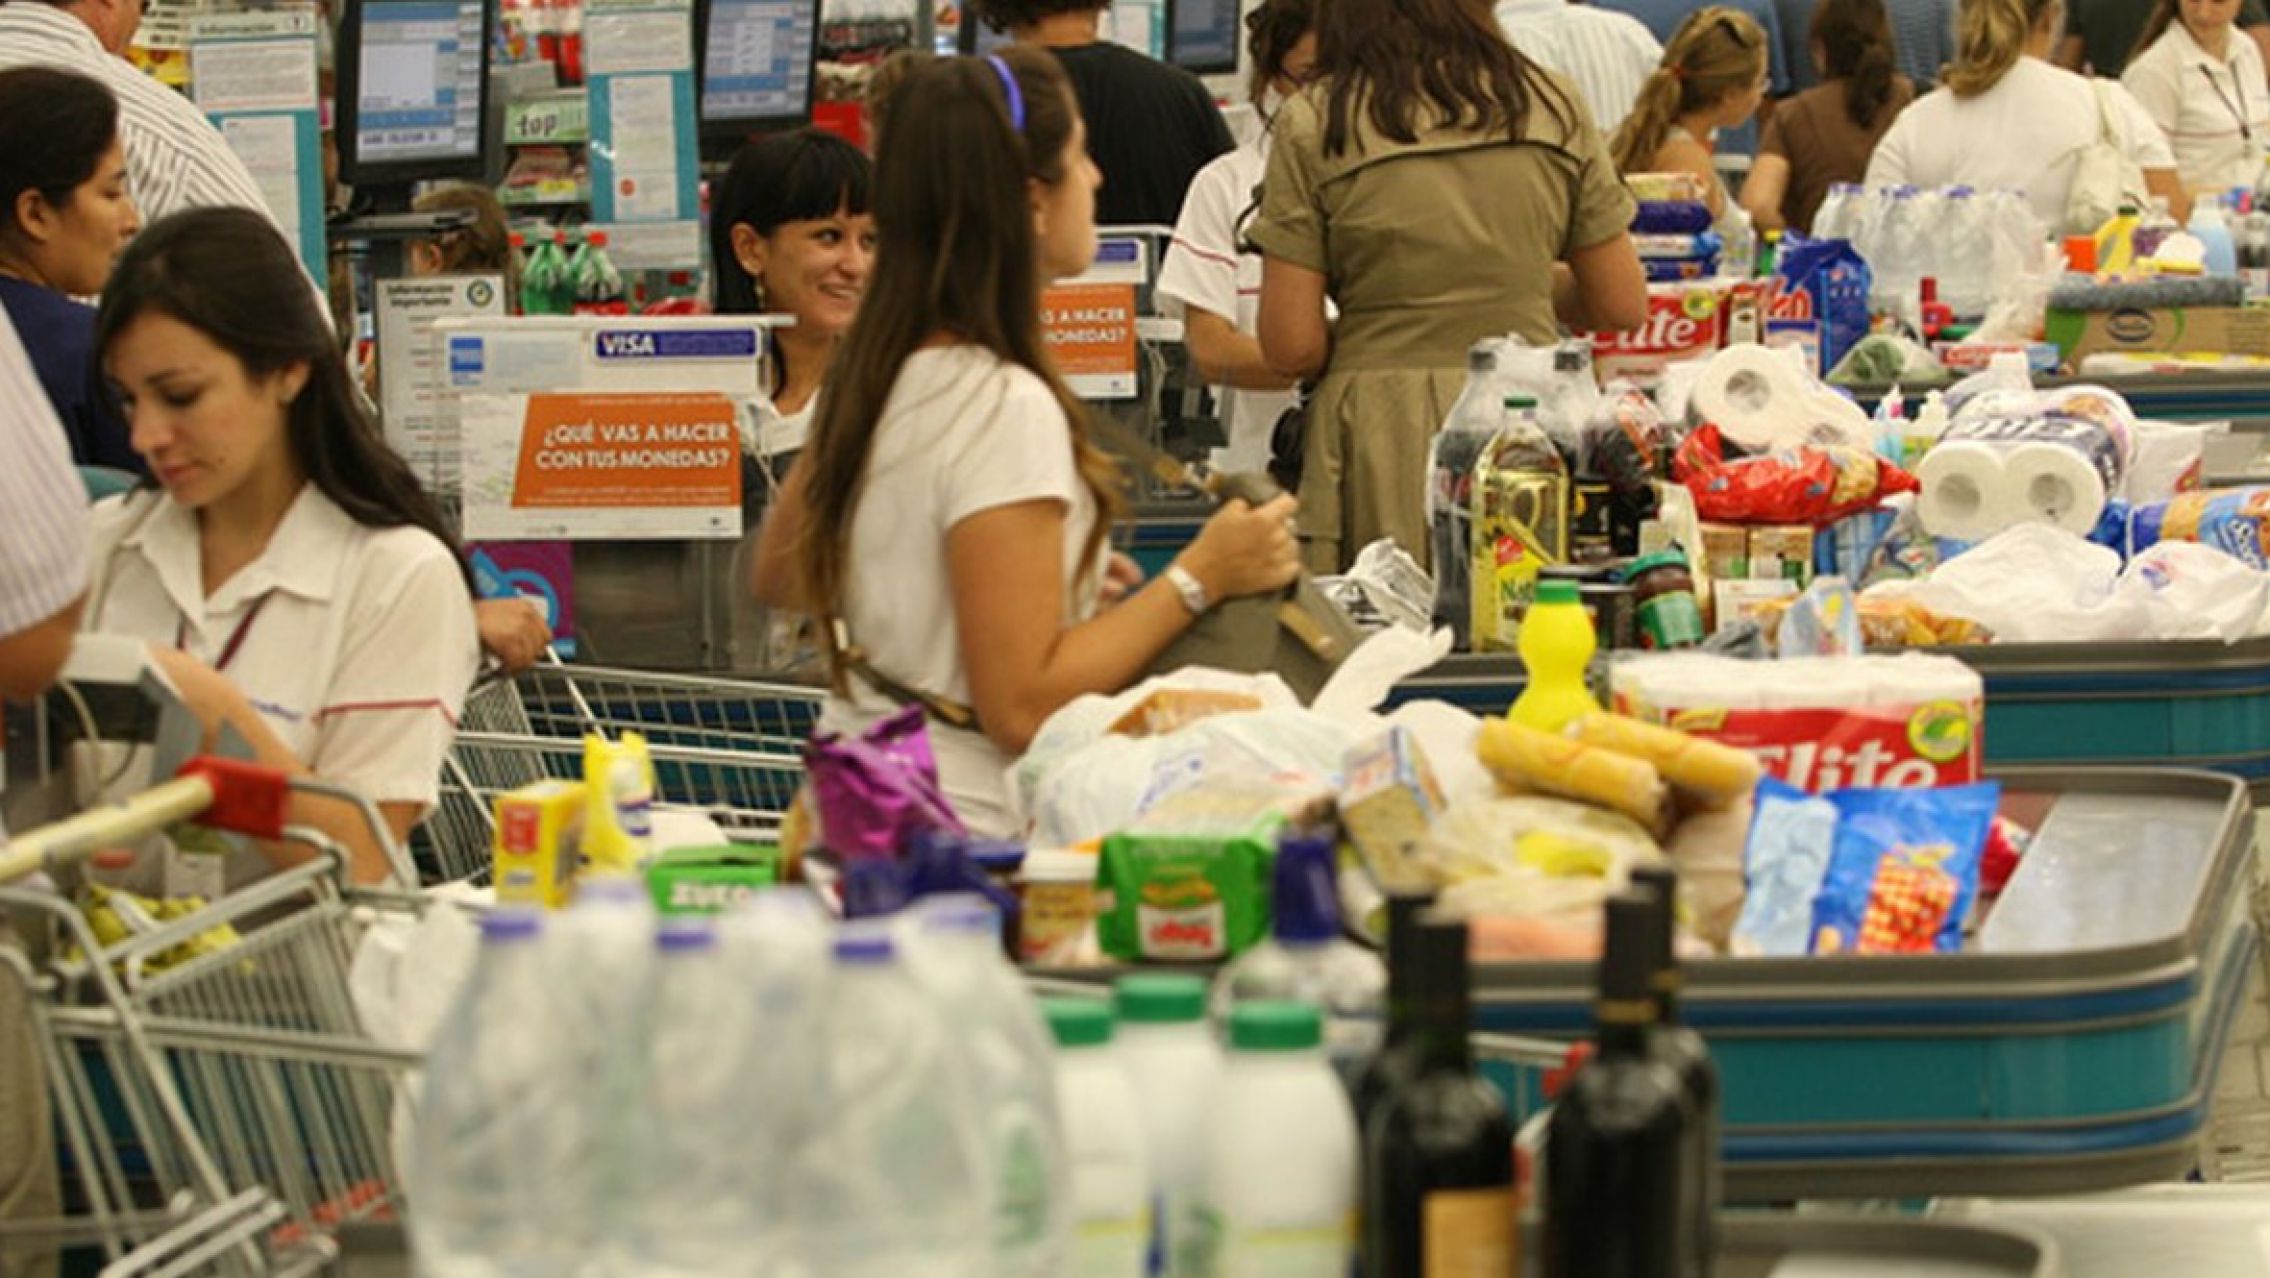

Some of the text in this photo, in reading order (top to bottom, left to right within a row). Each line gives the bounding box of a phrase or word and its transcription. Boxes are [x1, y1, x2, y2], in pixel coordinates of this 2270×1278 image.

[515, 112, 557, 138] top
[1072, 307, 1126, 321] HACER
[602, 334, 655, 354] VISA
[544, 418, 730, 446] ¿QUÉ VAS A HACER
[535, 448, 731, 469] CON TUS MONEDAS?
